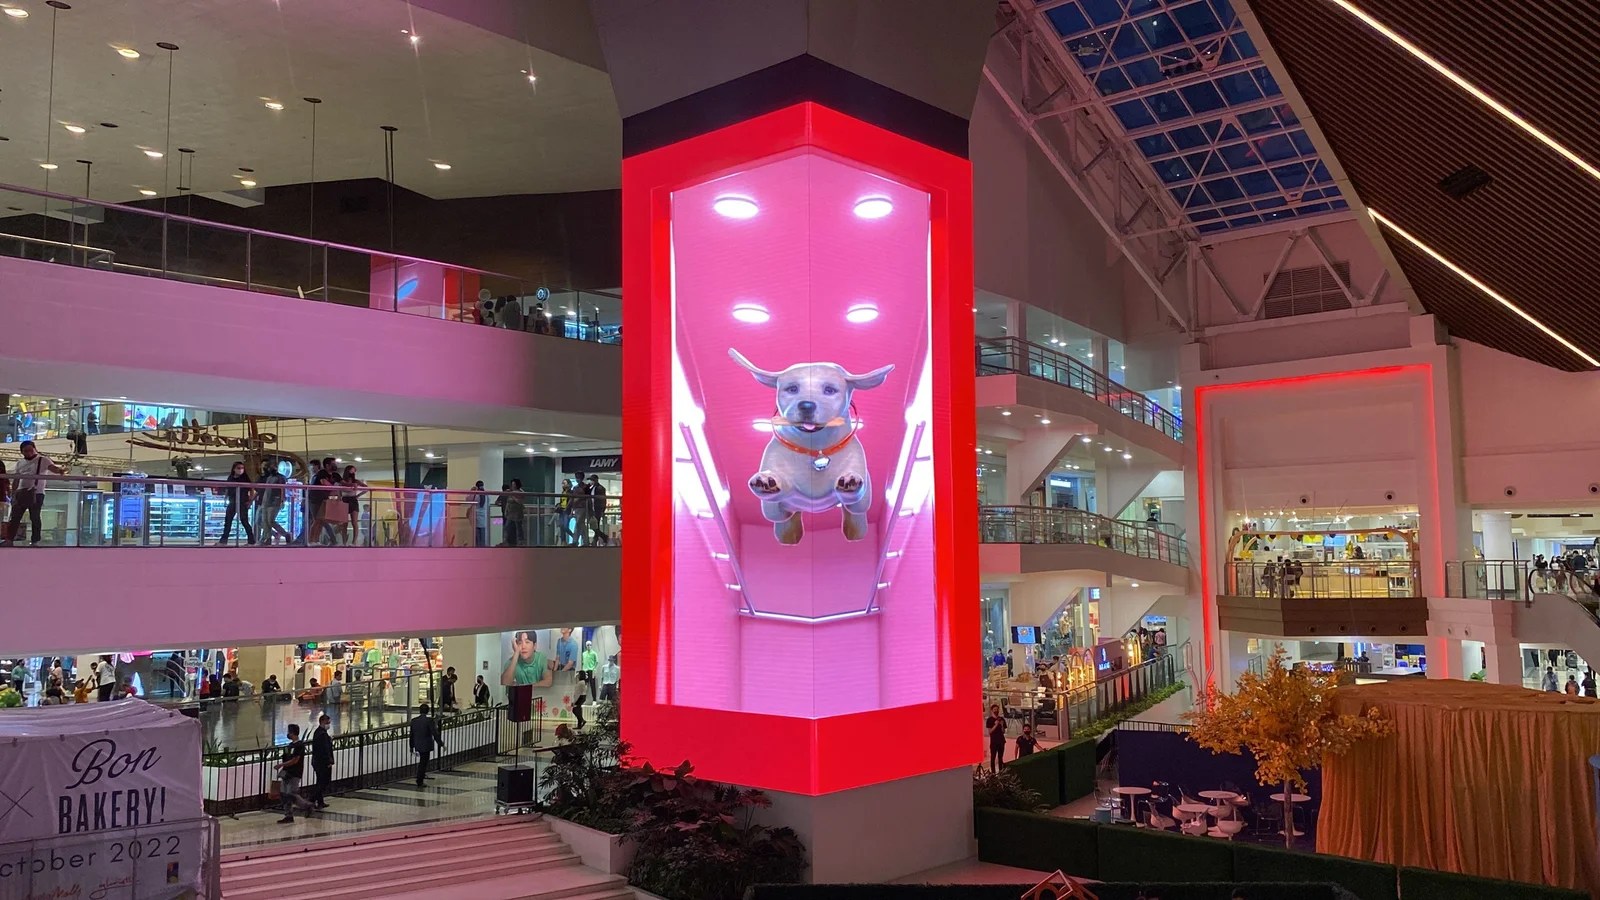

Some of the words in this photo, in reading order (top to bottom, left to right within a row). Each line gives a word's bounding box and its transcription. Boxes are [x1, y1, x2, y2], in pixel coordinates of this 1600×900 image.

[590, 458, 618, 467] LAMY
[65, 738, 162, 789] Bon
[59, 787, 166, 834] BAKERY!
[0, 848, 97, 877] ctober
[110, 835, 181, 863] 2022
